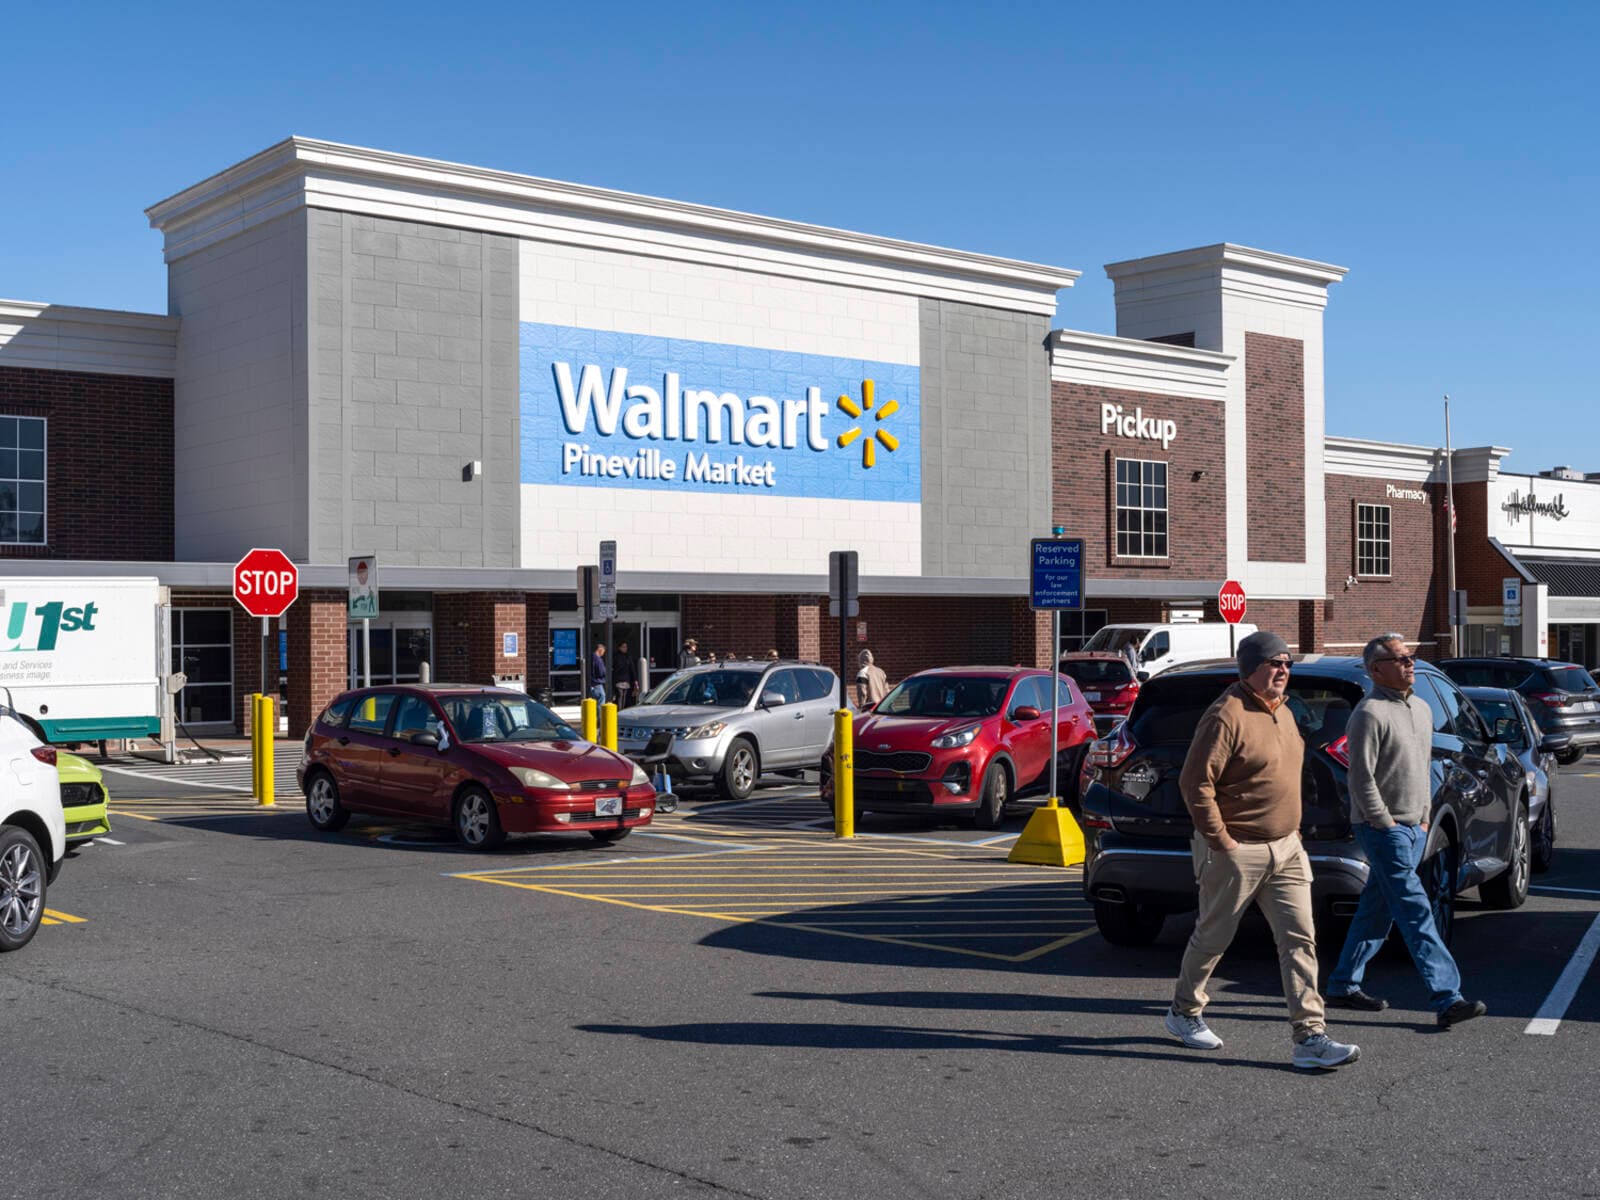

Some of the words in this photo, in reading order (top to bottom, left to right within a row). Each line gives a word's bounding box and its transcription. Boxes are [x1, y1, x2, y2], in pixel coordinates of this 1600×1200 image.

[552, 361, 829, 451] Walmart
[1101, 403, 1177, 450] Pickup
[563, 442, 676, 480] Pineville
[684, 452, 776, 486] Market
[1386, 484, 1428, 504] Pharmacy
[1506, 488, 1570, 524] Hallmark
[1035, 543, 1080, 553] Reserved
[1039, 555, 1076, 567] Parking
[238, 569, 294, 596] STOP
[1221, 593, 1245, 611] STOP
[2, 660, 18, 670] and
[19, 660, 53, 670] Services
